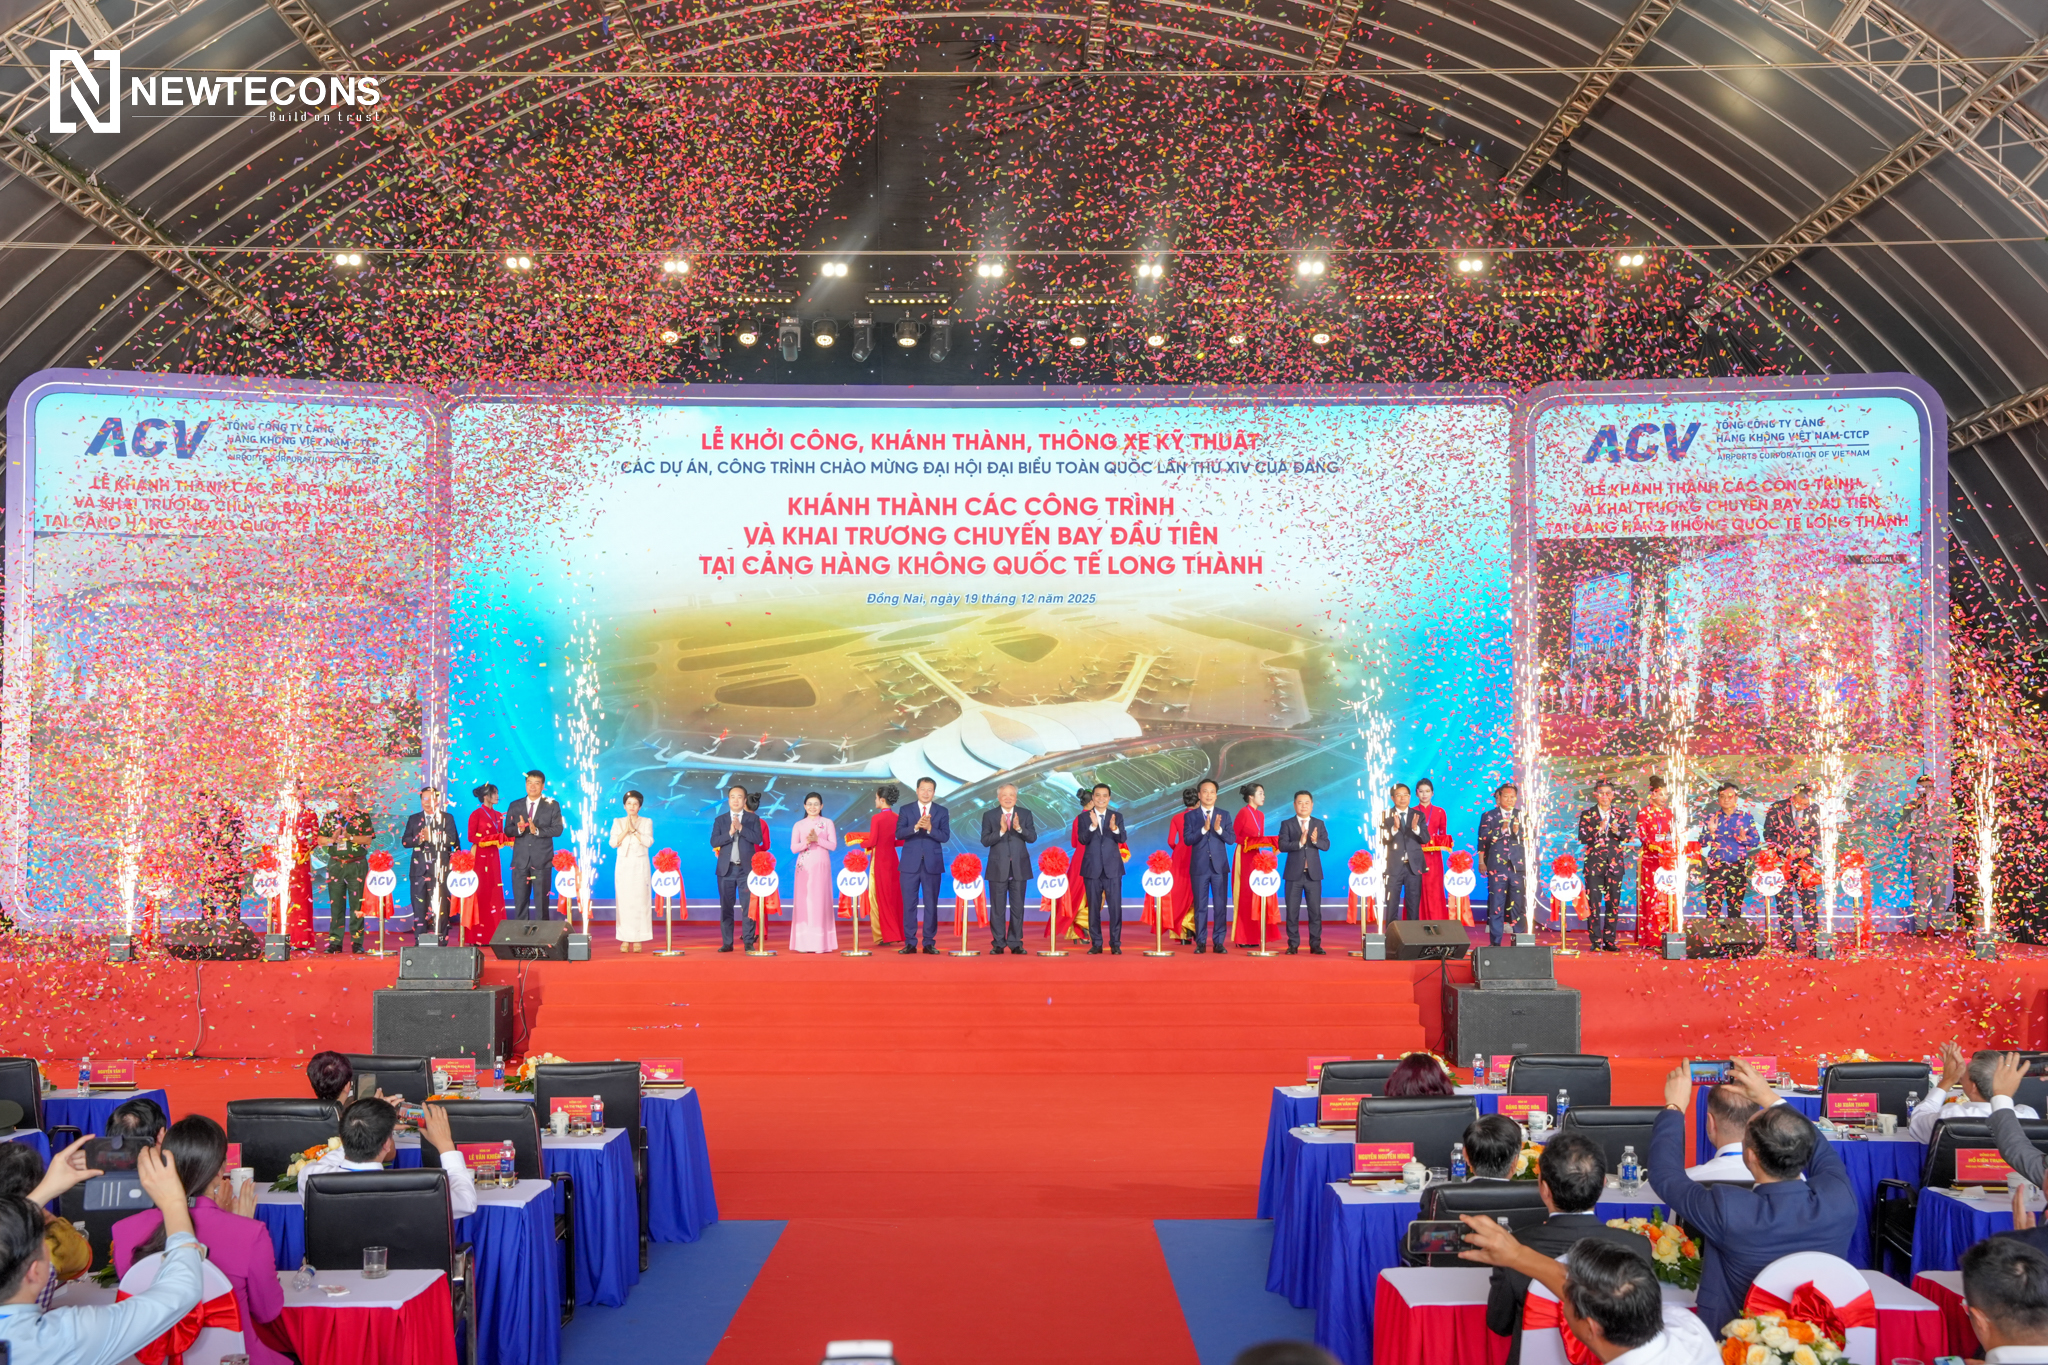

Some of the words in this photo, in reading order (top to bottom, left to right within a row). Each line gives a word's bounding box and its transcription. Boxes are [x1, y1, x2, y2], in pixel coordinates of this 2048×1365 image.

[1716, 418, 1744, 430] TỔNG
[1747, 418, 1775, 429] CÔNG
[1779, 419, 1791, 428] TY
[1795, 417, 1824, 427] CẢNG
[85, 417, 210, 458] ACV
[702, 426, 723, 449] LỄ
[731, 428, 783, 450] KHỞI
[791, 429, 863, 453] CÔNG,
[872, 429, 945, 450] KHÁNH
[953, 429, 1031, 453] THÀNH,
[1039, 429, 1117, 450] THÔNG
[1124, 433, 1149, 450] XE
[1156, 429, 1184, 450] KỸ
[1191, 429, 1260, 455] THUẬT
[1582, 422, 1701, 463] ACV
[1717, 452, 1757, 461] AIRPORTS
[1759, 450, 1817, 460] CORPORATION
[1819, 450, 1829, 458] OF
[1832, 449, 1870, 458] VIETNAM
[621, 459, 654, 474] CÁC
[661, 461, 682, 477] DỰ
[687, 459, 712, 475] ÁN,
[718, 459, 765, 474] CÔNG
[771, 459, 814, 474] TRÌNH
[821, 459, 865, 474] CHÀO
[872, 459, 918, 474] MỪNG
[924, 461, 949, 477] ĐẠI
[955, 459, 981, 477] HỘI
[987, 461, 1012, 477] ĐẠI
[1019, 459, 1050, 474] BIỂU
[1056, 459, 1098, 474] TOÀN
[1105, 459, 1151, 474] QUỐC
[1158, 459, 1185, 474] LẦN
[1227, 461, 1249, 474] XIV
[789, 492, 869, 515] KHÁNH
[877, 493, 956, 515] THÀNH
[965, 493, 1016, 515] CÁC
[1025, 492, 1098, 515] CÔNG
[1106, 492, 1173, 515] TRÌNH
[1773, 498, 1803, 512] BAY
[744, 522, 775, 545] VÀ
[783, 527, 837, 545] KHAI
[845, 525, 946, 545] TRƯƠNG
[954, 520, 1049, 545] CHUYẾN
[1059, 527, 1102, 545] BAY
[1111, 520, 1161, 545] ĐẦU
[1168, 521, 1217, 544] TIÊN
[699, 556, 734, 580] TẠI
[743, 550, 813, 574] CẢNG
[822, 551, 890, 574] HÀNG
[899, 551, 986, 574] KHÔNG
[994, 549, 1066, 575] QUỐC
[1074, 549, 1102, 574] TẾ
[1109, 556, 1175, 574] LONG
[1183, 551, 1262, 574] THÀNH
[867, 592, 899, 605] Đồng
[902, 593, 926, 606] Nai,
[930, 594, 960, 607] ngày
[964, 593, 978, 604] 19
[980, 592, 1016, 607] tháng
[1021, 593, 1034, 604] 12
[1037, 593, 1064, 605] năm
[1067, 593, 1097, 604] 2025
[368, 876, 396, 886] ACV
[449, 877, 477, 888] ACV
[557, 878, 576, 887] AC
[653, 876, 681, 887] ACV
[749, 877, 778, 888] ACV
[839, 876, 866, 887] ACV
[954, 879, 983, 890] ACV
[1039, 877, 1067, 889] ACV
[1144, 876, 1172, 887] ACV
[1251, 876, 1278, 887] ACV
[1351, 876, 1378, 887] ACV
[1446, 876, 1474, 887] ACV
[1554, 880, 1580, 891] ACV
